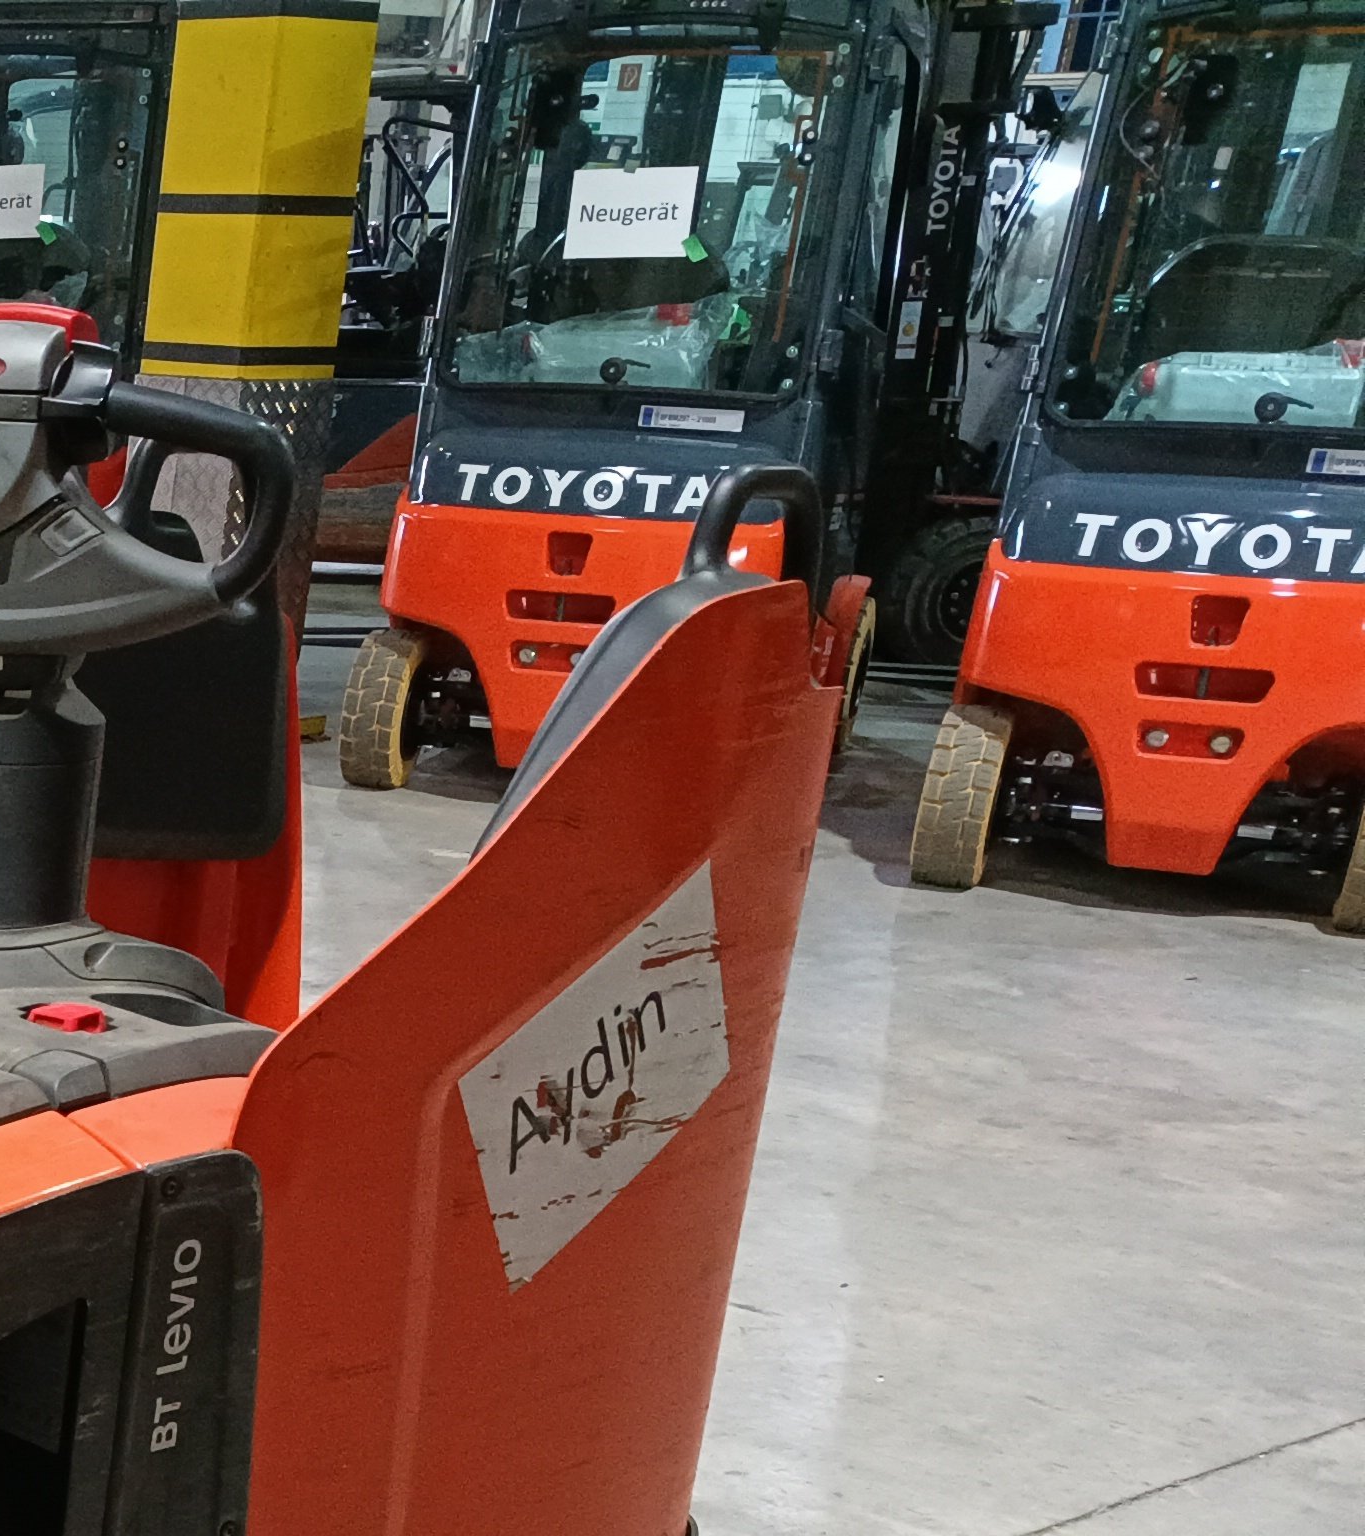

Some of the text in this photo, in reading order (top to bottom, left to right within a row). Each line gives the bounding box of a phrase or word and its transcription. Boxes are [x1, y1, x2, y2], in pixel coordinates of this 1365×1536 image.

[925, 124, 961, 236] TOYOTA
[579, 202, 679, 226] Neugerät
[458, 463, 709, 515] TOYOTA
[1074, 512, 1365, 574] TOYOT
[509, 990, 667, 1175] Aydin
[150, 1396, 182, 1454] BT
